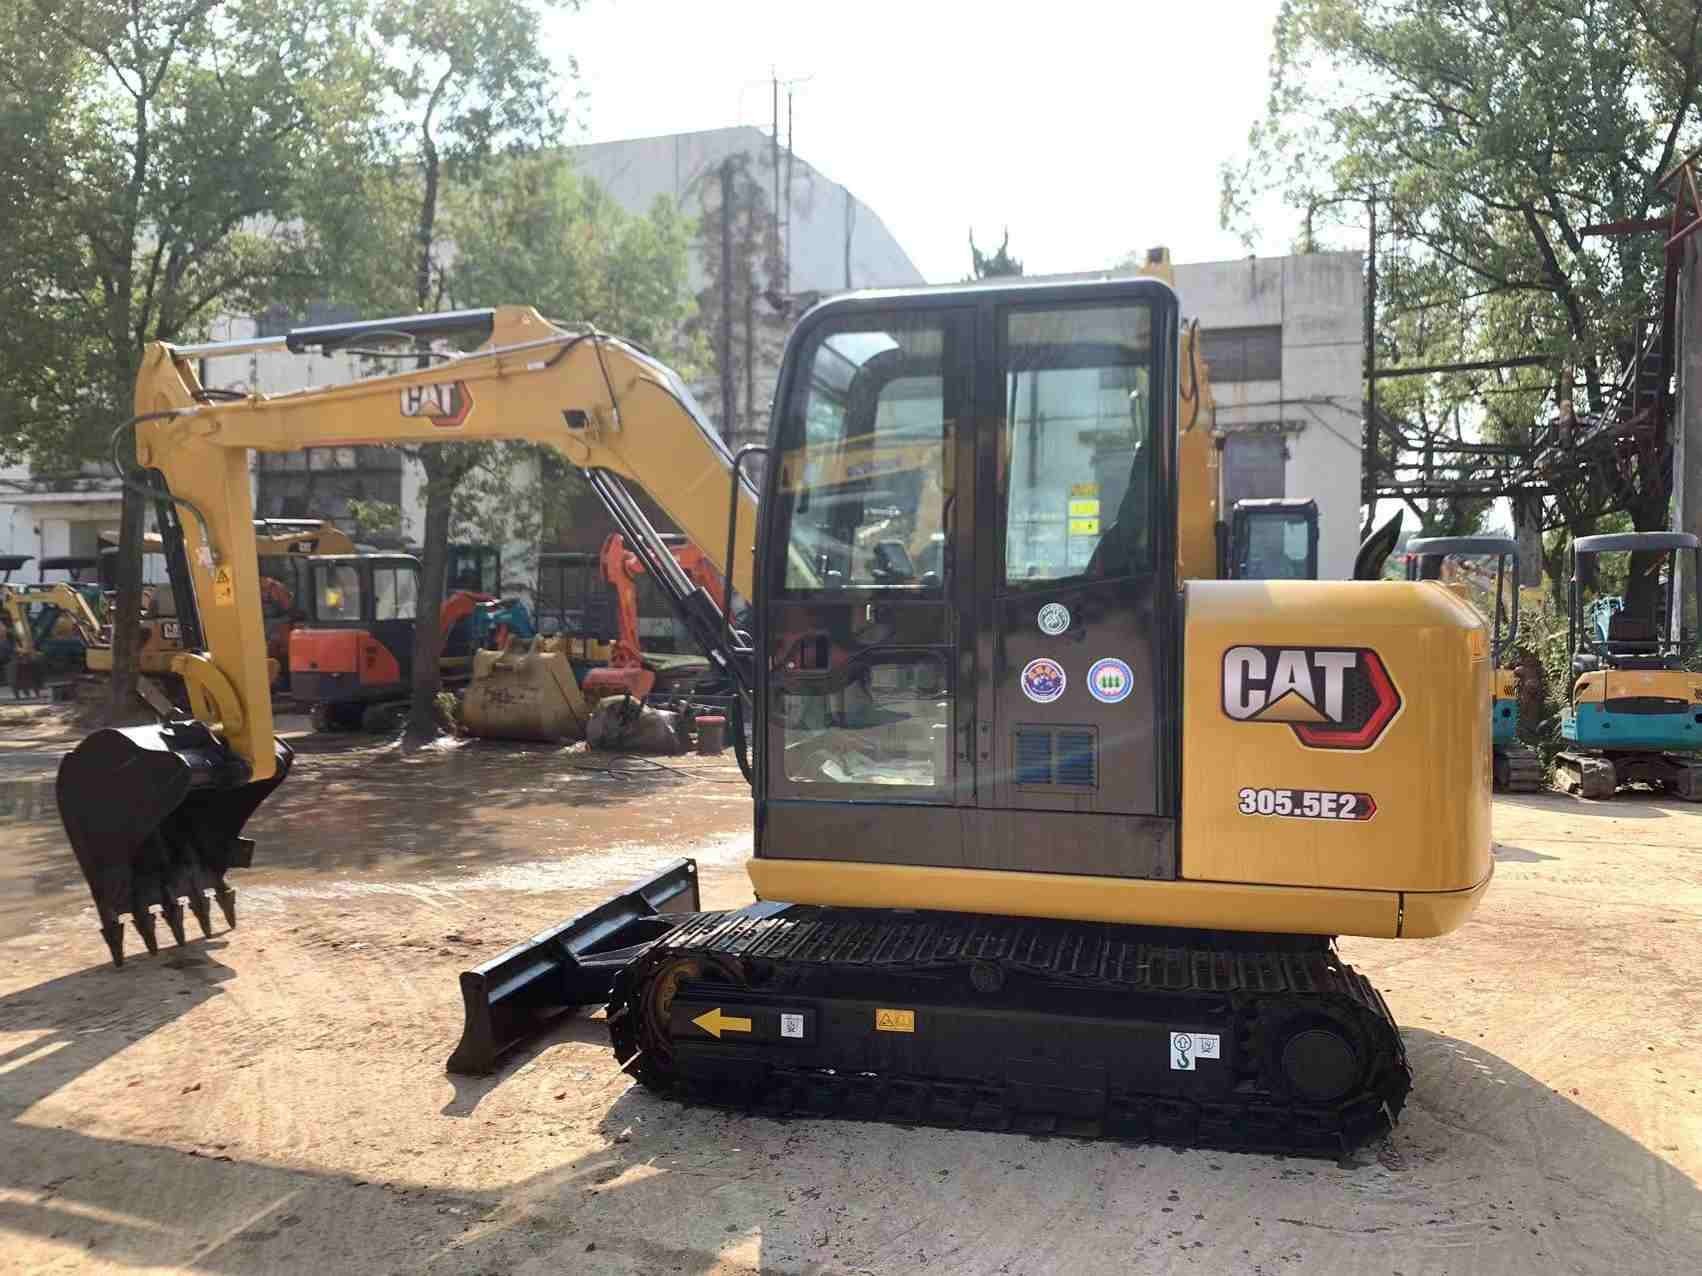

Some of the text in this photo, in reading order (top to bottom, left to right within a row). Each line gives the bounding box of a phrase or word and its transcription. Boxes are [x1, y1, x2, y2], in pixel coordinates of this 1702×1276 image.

[401, 383, 455, 416] CAT
[1224, 647, 1357, 722] CAT
[1240, 788, 1356, 817] 305.5E2
